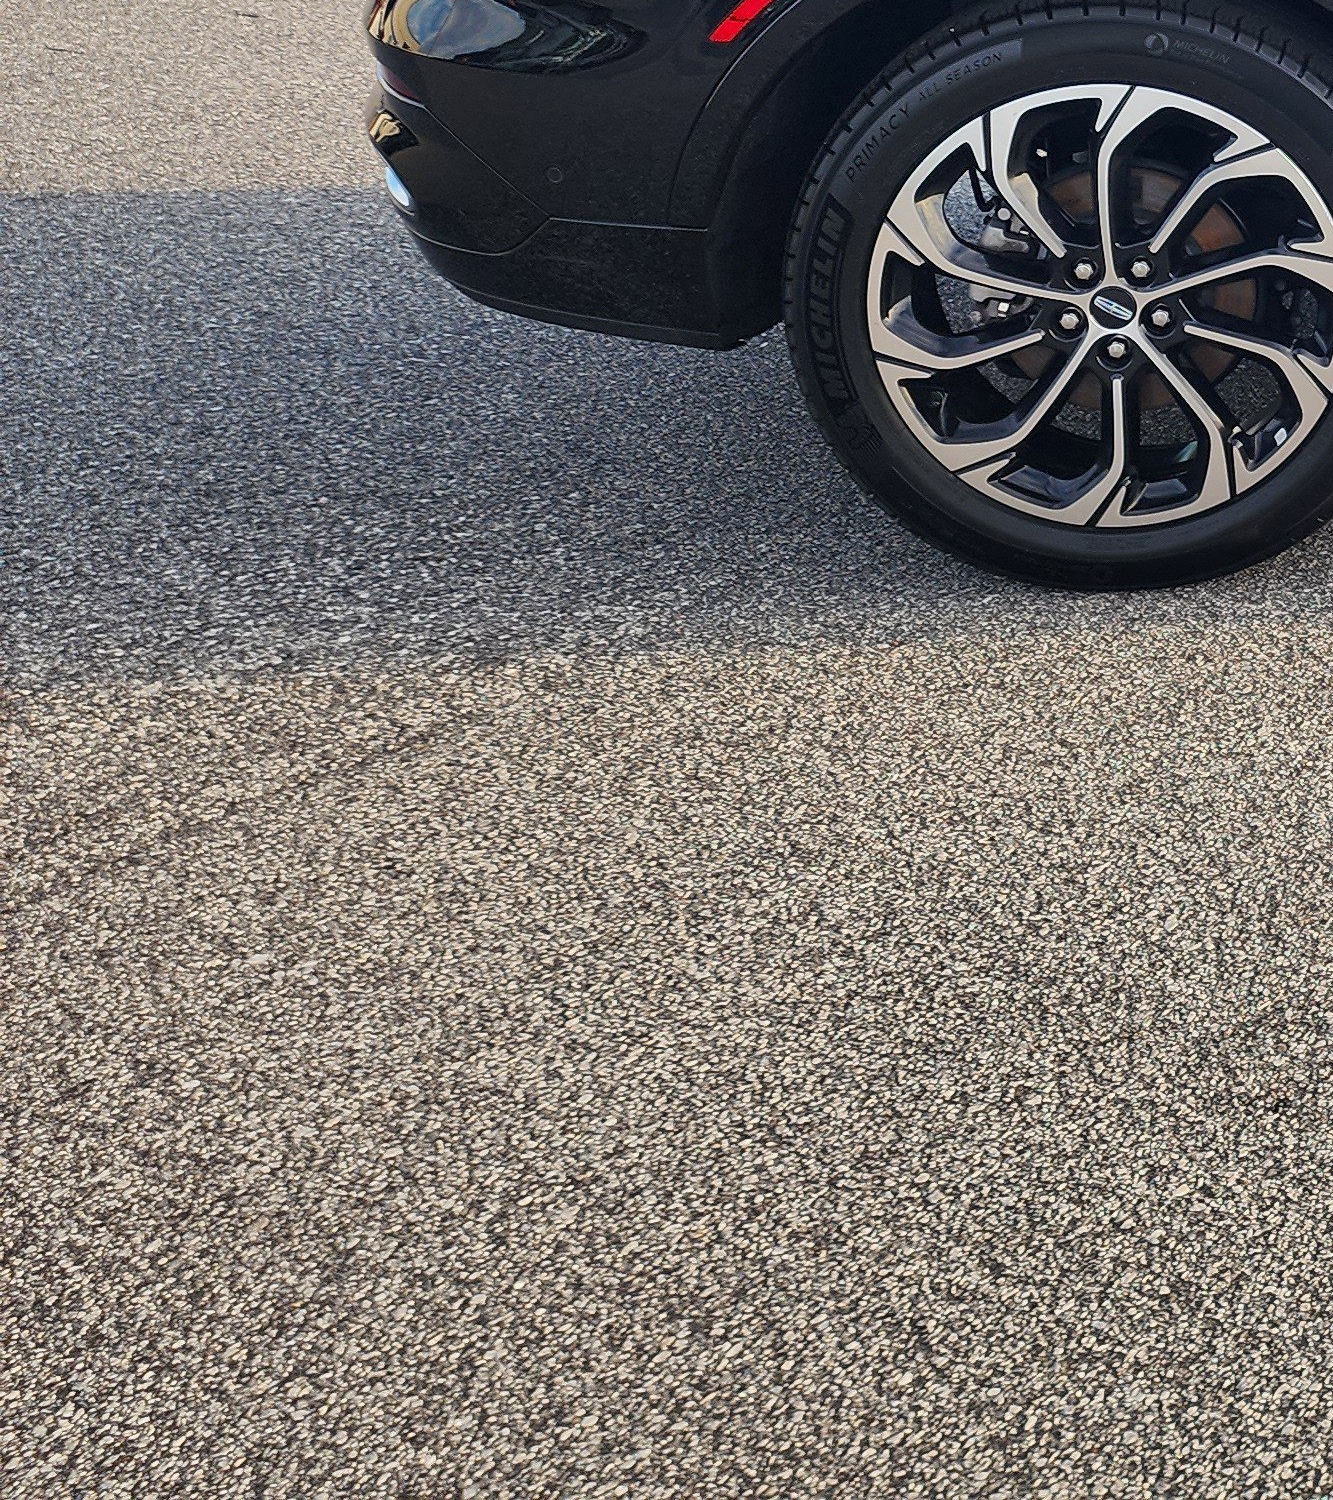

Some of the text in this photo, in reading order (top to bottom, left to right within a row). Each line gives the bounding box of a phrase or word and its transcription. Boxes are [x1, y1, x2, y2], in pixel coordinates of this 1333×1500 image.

[844, 51, 1002, 183] PRIMACY ALL SEASON
[810, 207, 849, 398] MICHELIN
